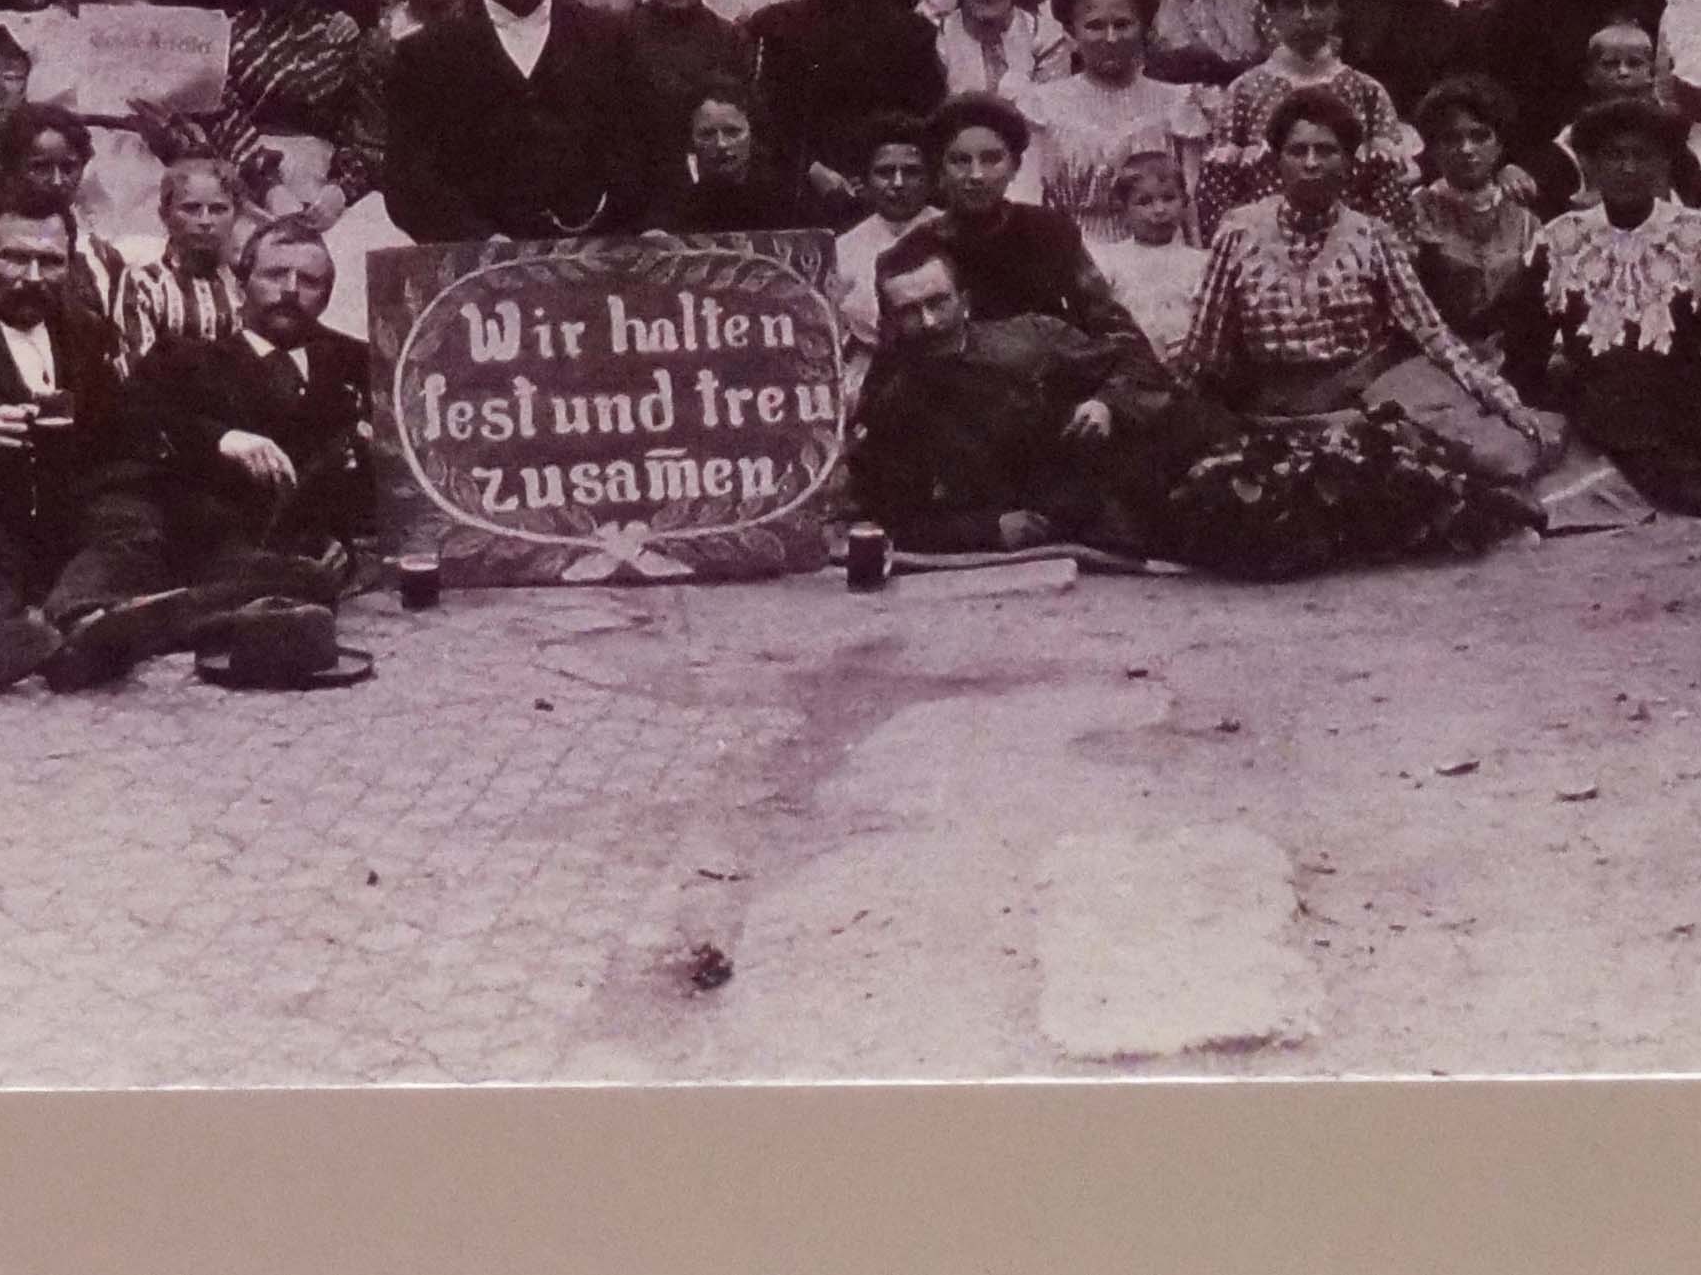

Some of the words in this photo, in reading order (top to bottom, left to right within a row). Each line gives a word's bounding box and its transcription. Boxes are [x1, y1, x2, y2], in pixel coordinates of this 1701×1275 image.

[460, 300, 586, 363] Wir
[607, 291, 795, 354] halten
[553, 368, 675, 435] und
[695, 367, 837, 429] treu
